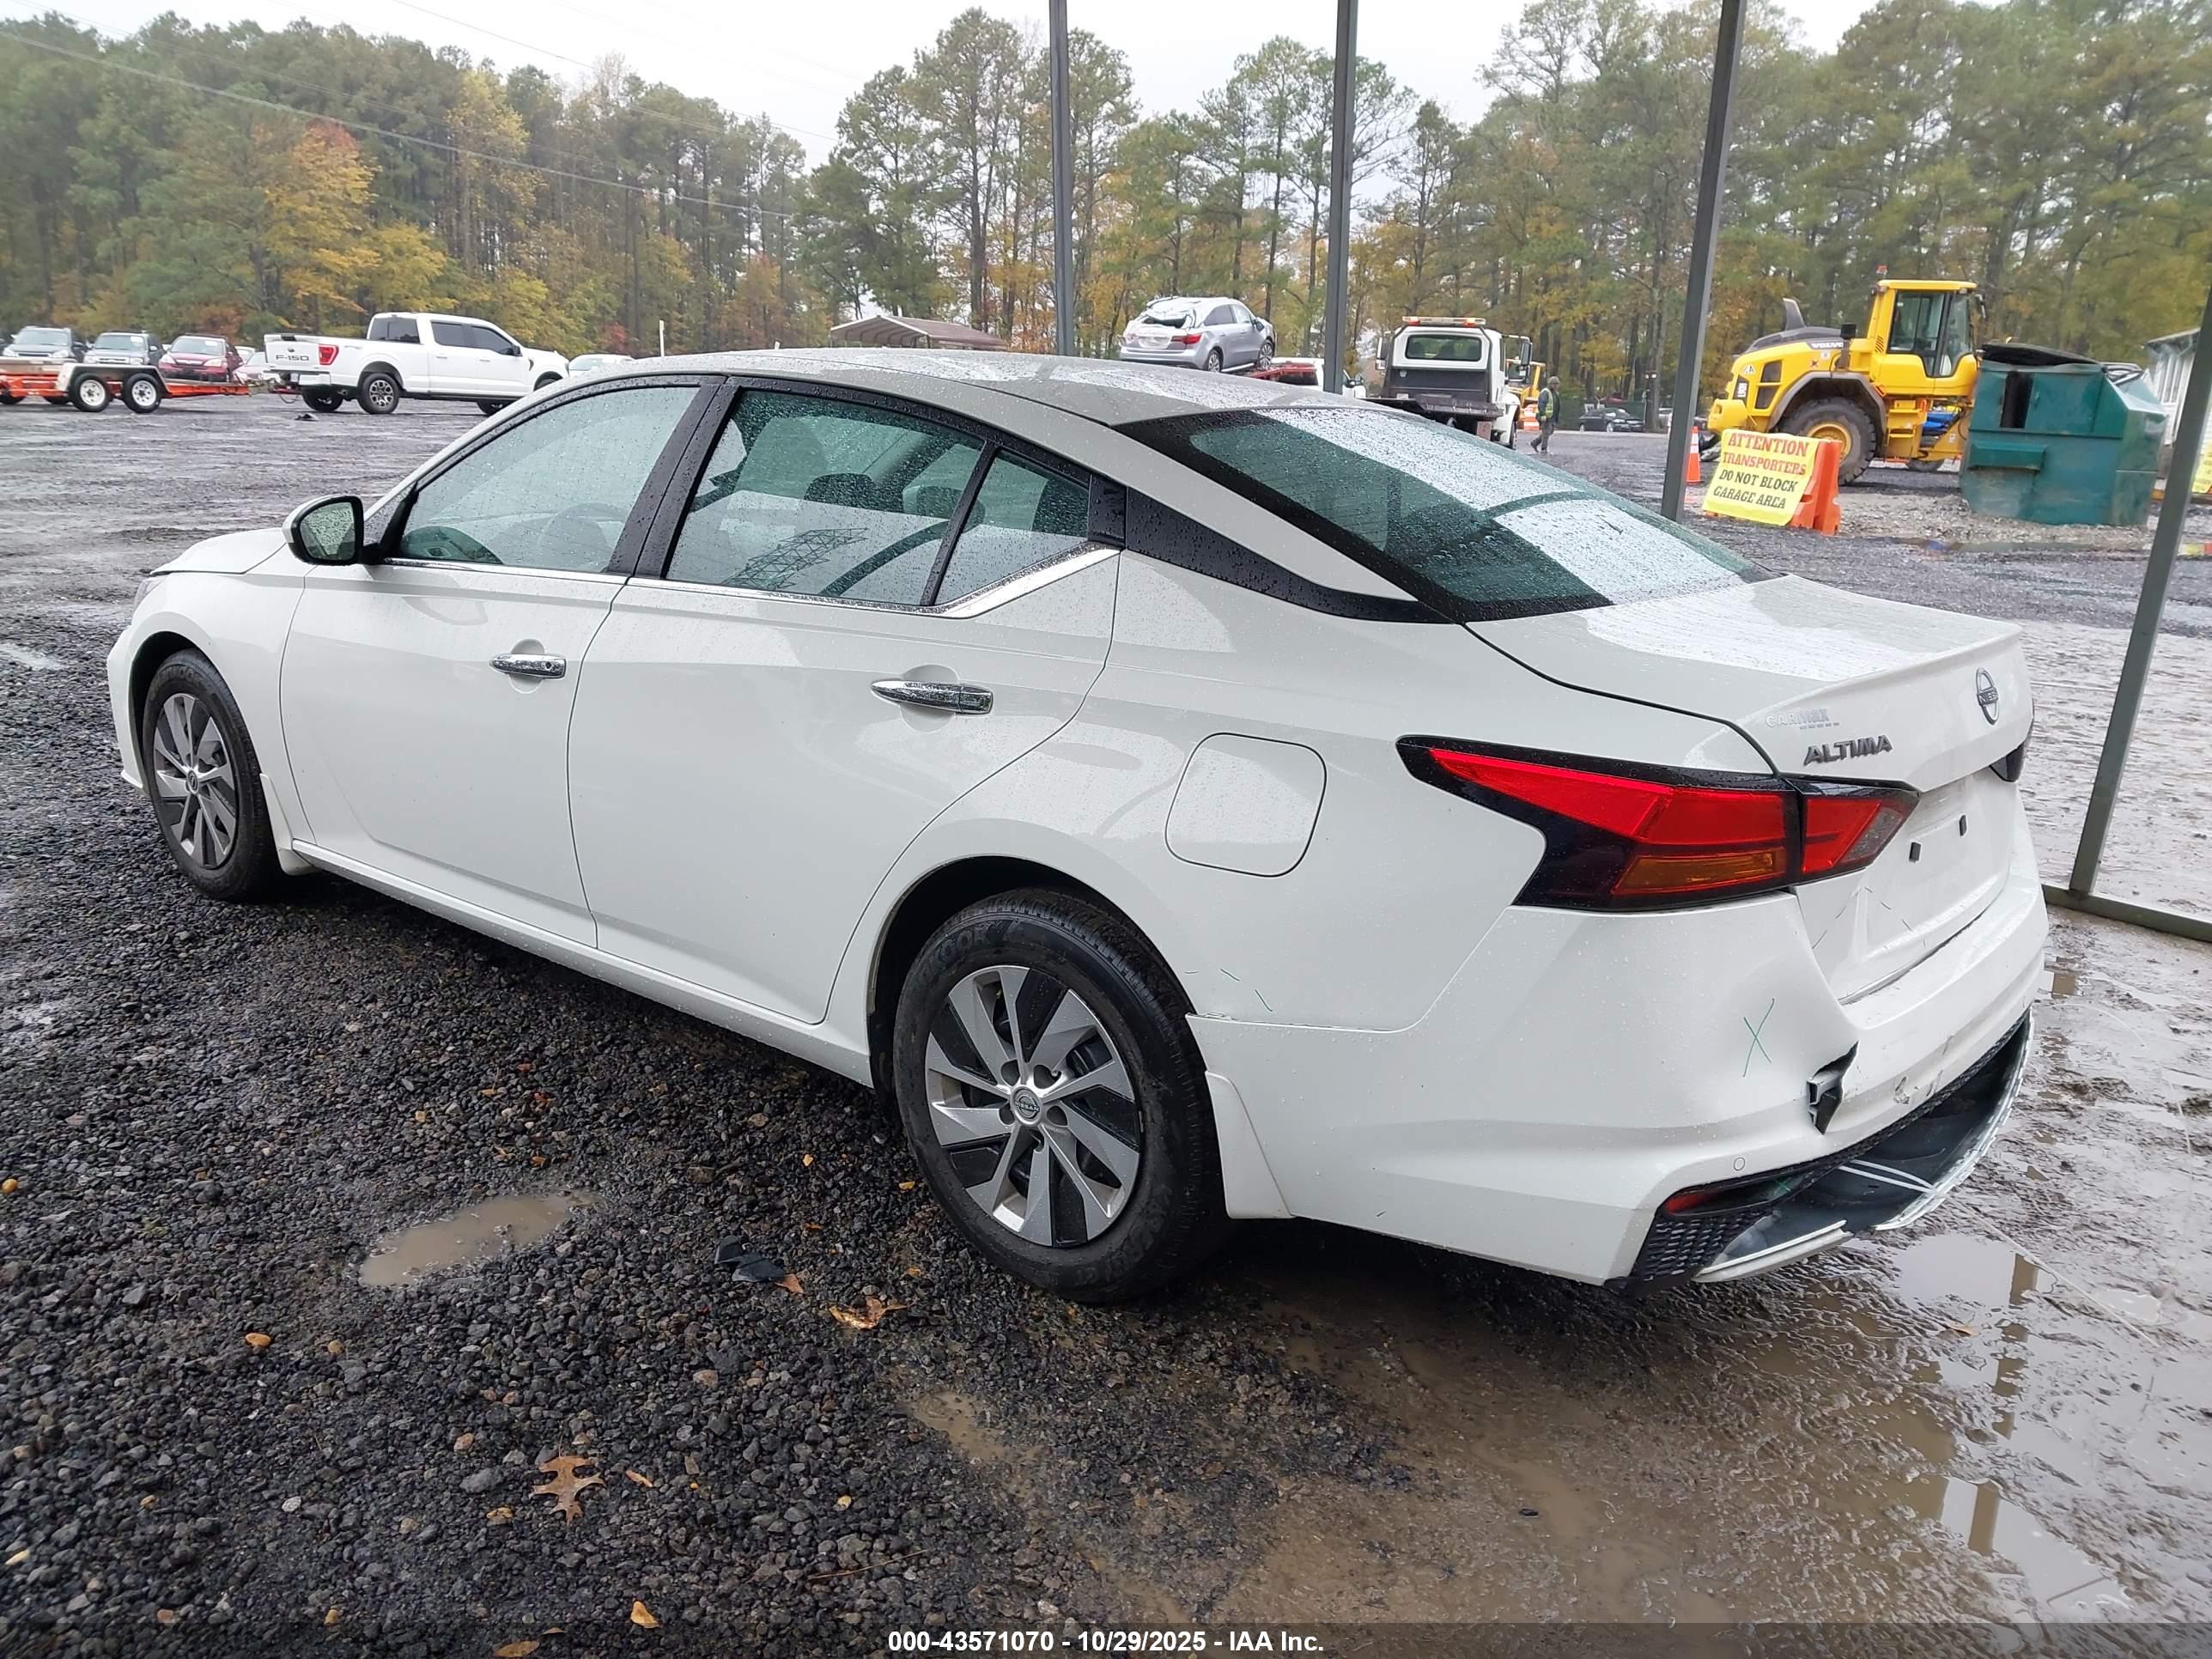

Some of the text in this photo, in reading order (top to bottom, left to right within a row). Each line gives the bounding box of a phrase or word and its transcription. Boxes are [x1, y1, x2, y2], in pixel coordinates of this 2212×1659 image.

[1728, 432, 1809, 457] ATTENTION
[1723, 452, 1807, 476] TRANSPORTERS
[1719, 469, 1799, 492] DO NOT BLOCK
[1713, 485, 1786, 509] GARAGE AREA
[1803, 734, 1893, 767] ALTIMA
